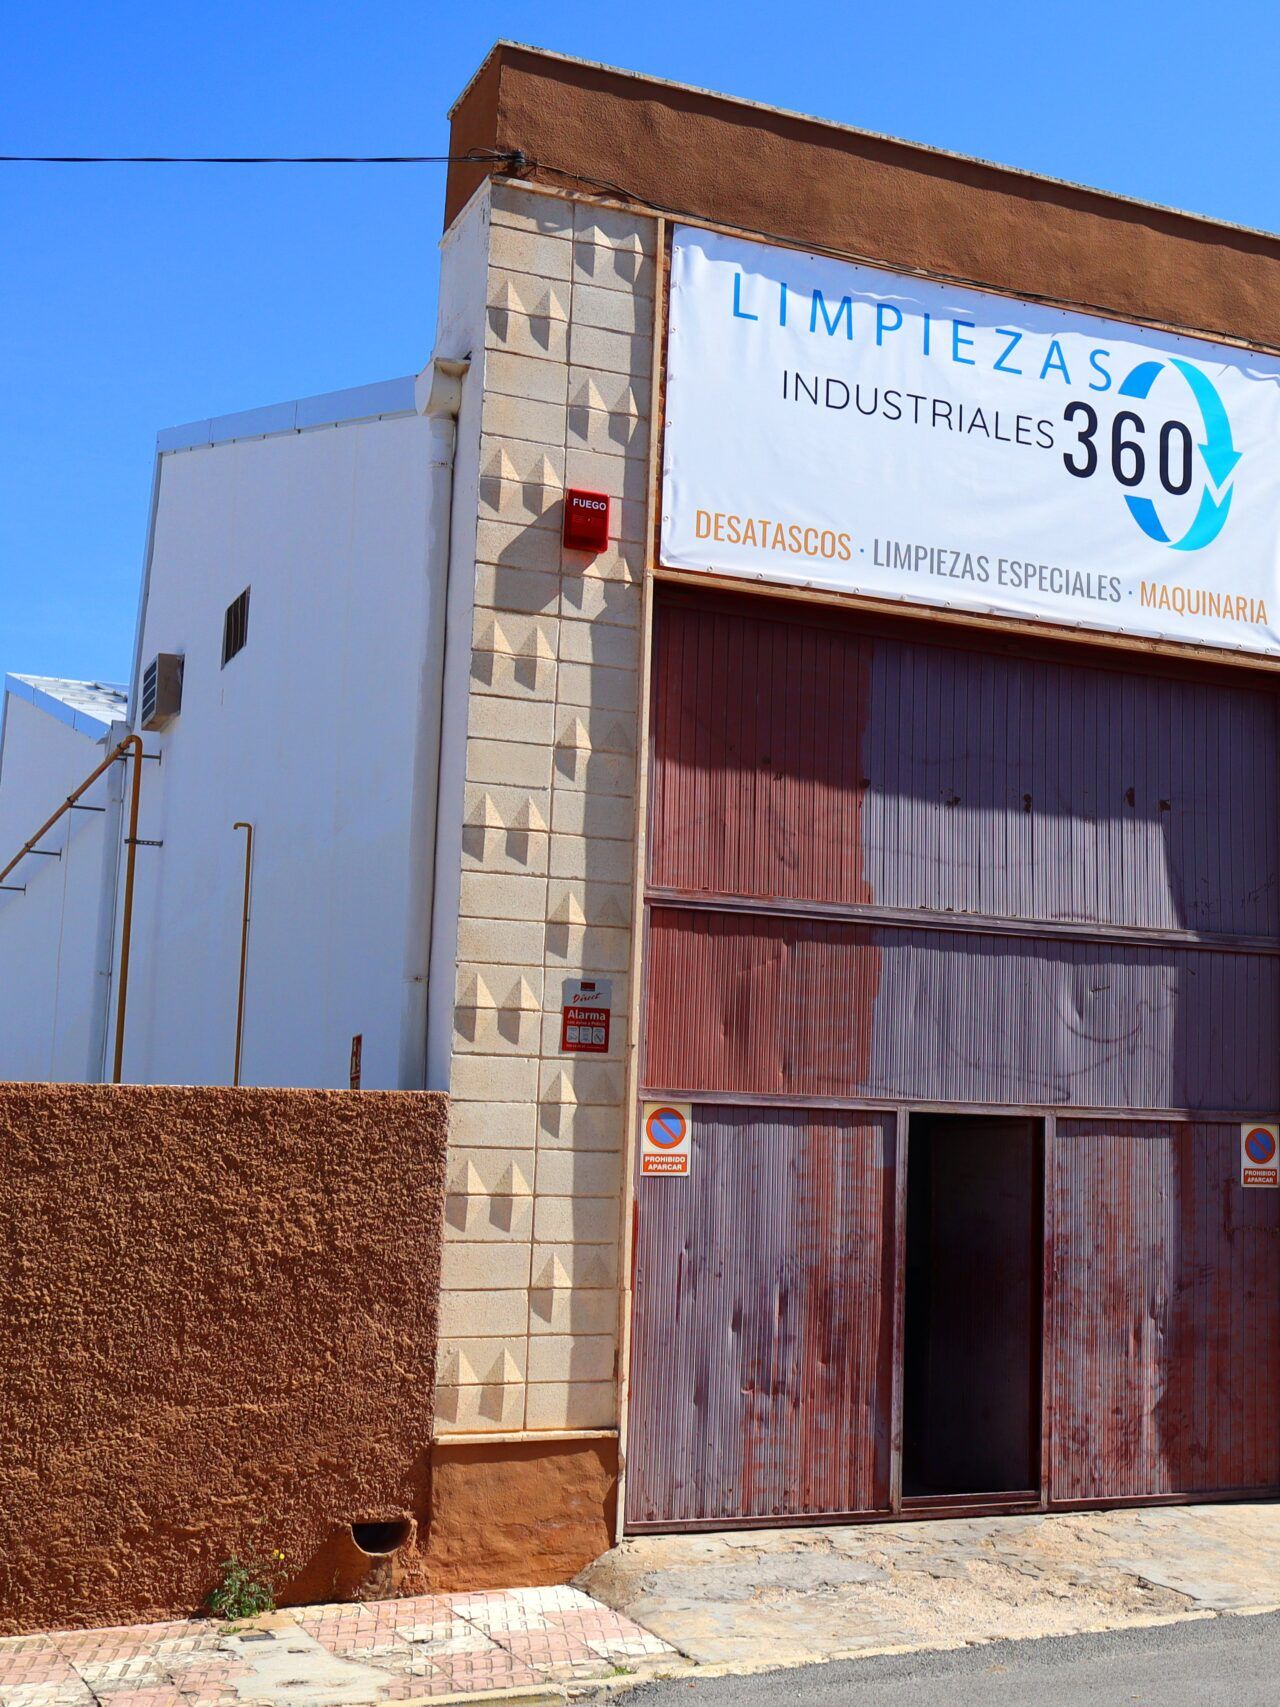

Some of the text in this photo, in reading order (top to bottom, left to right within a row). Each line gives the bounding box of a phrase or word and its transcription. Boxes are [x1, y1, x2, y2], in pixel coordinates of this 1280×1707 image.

[733, 272, 1112, 392] LIMPIEZAS
[783, 370, 1193, 496] INDUSTRIALES 360
[573, 498, 607, 511] FUEGO
[695, 509, 1268, 625] DESATASCOS LIMPIEZAS ESPECIALES MAQUINARIA
[568, 1009, 606, 1020] Alarma
